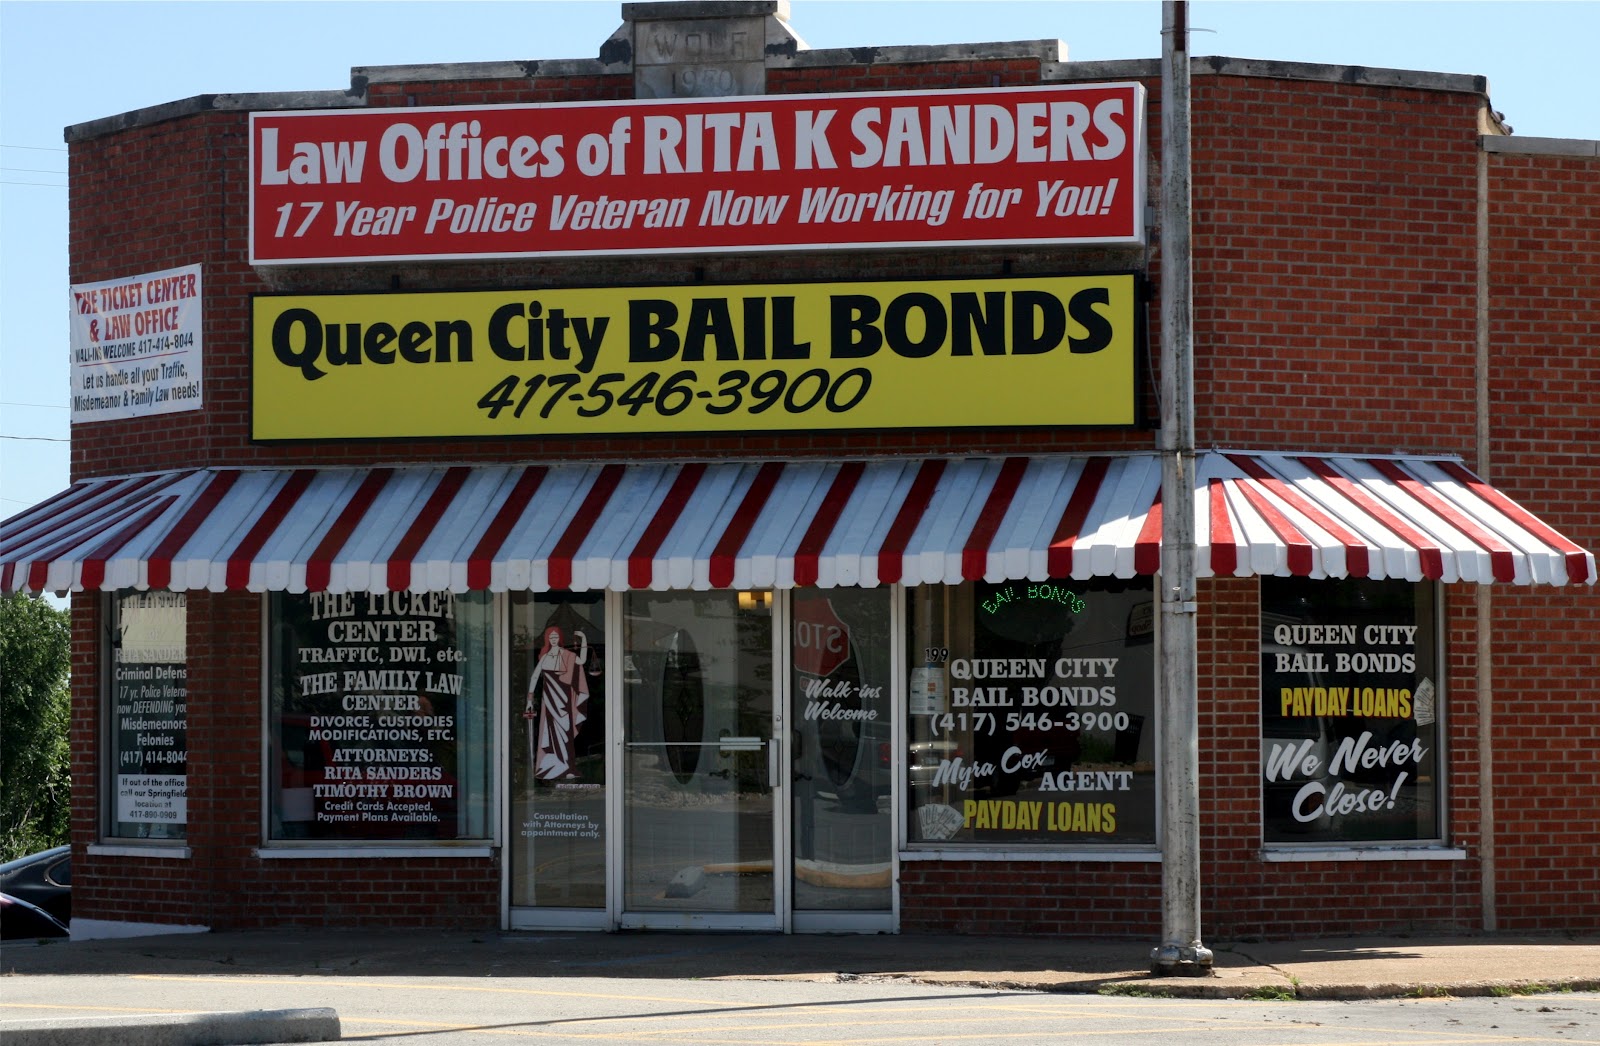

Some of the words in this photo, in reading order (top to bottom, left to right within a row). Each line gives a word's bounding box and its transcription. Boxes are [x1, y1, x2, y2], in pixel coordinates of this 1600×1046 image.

[654, 31, 747, 58] WOLF
[260, 127, 367, 186] Law
[379, 119, 565, 184] Offices
[576, 116, 631, 177] of
[643, 111, 780, 175] RITA
[794, 110, 838, 170] K
[850, 98, 1127, 169] SANDERS
[274, 202, 323, 238] 17
[333, 197, 417, 237] Year
[424, 197, 538, 235] Police
[548, 194, 690, 232] Veteran
[698, 189, 789, 227] Now
[798, 184, 956, 226] Working
[962, 182, 1022, 219] for
[1035, 178, 1119, 218] You!
[74, 291, 98, 315] THE
[100, 283, 142, 311] TICKET
[146, 274, 197, 304] CENTER
[89, 318, 99, 343] &
[104, 313, 131, 341] LAW
[134, 305, 179, 337] OFFICE
[271, 308, 473, 381] Queen
[488, 300, 610, 374] City
[628, 296, 812, 363] BAIL
[829, 287, 1113, 359] BONDS
[103, 341, 136, 360] WELCOME
[138, 331, 194, 354] 417-414-8044
[82, 373, 94, 390] Let
[95, 374, 103, 388] us
[105, 368, 129, 387] handle
[130, 367, 140, 384] all
[141, 366, 159, 387] your
[161, 361, 188, 380] Traffic,
[74, 395, 121, 412] Misdemeanor
[123, 390, 129, 407] &
[130, 388, 154, 407] Family
[155, 386, 170, 403] Law
[171, 381, 200, 400] needs!
[476, 367, 873, 420] 417-546-3900
[310, 590, 355, 621] THE
[364, 590, 456, 619] TICKET
[1027, 584, 1086, 614] BONDS
[327, 620, 438, 643] CENTER
[1273, 624, 1357, 645] QUEEN
[1363, 625, 1418, 645] CITY
[142, 648, 187, 662] SANDER
[299, 647, 384, 665] TRAFFIC,
[388, 646, 431, 664] DWI,
[436, 647, 467, 663] etc.
[925, 648, 949, 663] 199
[1275, 653, 1329, 673] BAIL
[1336, 653, 1416, 673] BONDS
[115, 666, 153, 680] Criminal
[156, 665, 187, 680] Defens
[950, 658, 1047, 680] QUEEN
[1054, 658, 1119, 678] CITY
[120, 686, 129, 699] 17
[140, 685, 161, 698] Police
[301, 672, 337, 696] THE
[343, 670, 420, 691] FAMILY
[425, 671, 463, 695] LAW
[805, 678, 882, 699] Walk-ins
[342, 695, 421, 711] CENTER
[952, 687, 1014, 707] BAIL
[1021, 686, 1116, 707] BONDS
[1280, 687, 1349, 717] PAYDAY
[1353, 688, 1412, 719] LOANS
[116, 704, 131, 714] now
[132, 701, 174, 714] DEFENDING
[804, 700, 878, 721] Welcome
[121, 717, 187, 731] Misdemeanors
[310, 716, 375, 728] DIVORCE,
[378, 716, 454, 728] CUSTODIES
[930, 712, 996, 736] (417)
[1005, 711, 1130, 731] 546-3900
[137, 733, 174, 746] Felonies
[309, 729, 424, 742] MODIFICATIONS,
[427, 730, 455, 741] ETC.
[120, 750, 143, 767] (417)
[332, 749, 434, 763] ATTORNEYS:
[1265, 738, 1323, 783] We
[1328, 730, 1429, 776] Never
[324, 767, 362, 780] RITA
[366, 767, 442, 780] SANDERS
[932, 757, 996, 791] Myra
[1001, 746, 1047, 773] Cox
[122, 778, 129, 786] If
[129, 779, 141, 787] out
[142, 778, 150, 787] of
[151, 779, 163, 787] the
[164, 779, 185, 787] office
[313, 784, 389, 798] TIMOTHY
[393, 784, 453, 798] BROWN
[1038, 771, 1133, 791] AGENT
[147, 788, 187, 800] Springfield
[1292, 771, 1408, 823] Close!
[129, 810, 177, 819] 417-890-0909
[324, 801, 354, 811] Credit
[356, 801, 385, 811] Cards
[386, 801, 434, 812] Accepted.
[533, 812, 589, 821] Consultation
[963, 800, 1043, 830] PAYDAY
[1047, 801, 1116, 833] LOANS
[317, 813, 360, 824] Payment
[362, 813, 389, 823] Plans
[391, 813, 441, 823] Available.
[522, 821, 542, 829] with
[543, 821, 586, 831] Attorneys
[588, 821, 600, 831] by
[521, 829, 578, 838] appointment
[580, 830, 600, 838] only.
